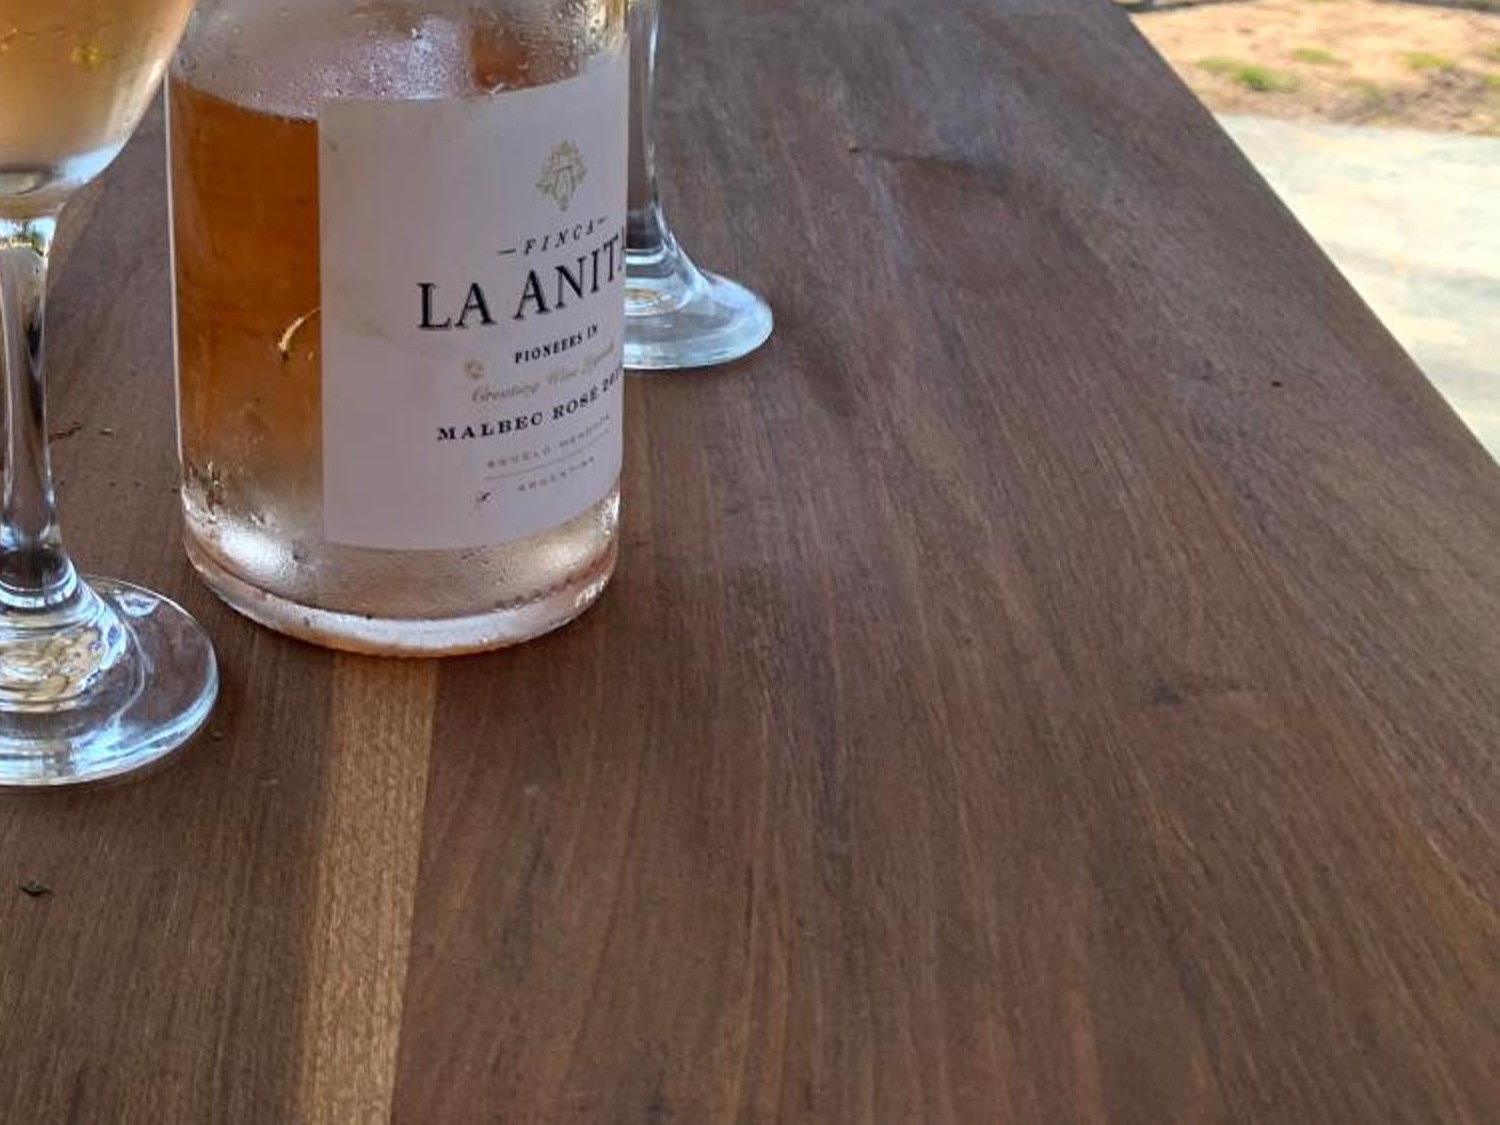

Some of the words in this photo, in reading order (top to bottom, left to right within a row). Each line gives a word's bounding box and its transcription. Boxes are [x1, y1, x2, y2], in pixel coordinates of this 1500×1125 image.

[523, 219, 594, 256] FINCA
[416, 281, 498, 329] LA
[513, 334, 583, 364] PIONEERS
[587, 323, 598, 341] IN
[436, 411, 543, 442] MALBEC
